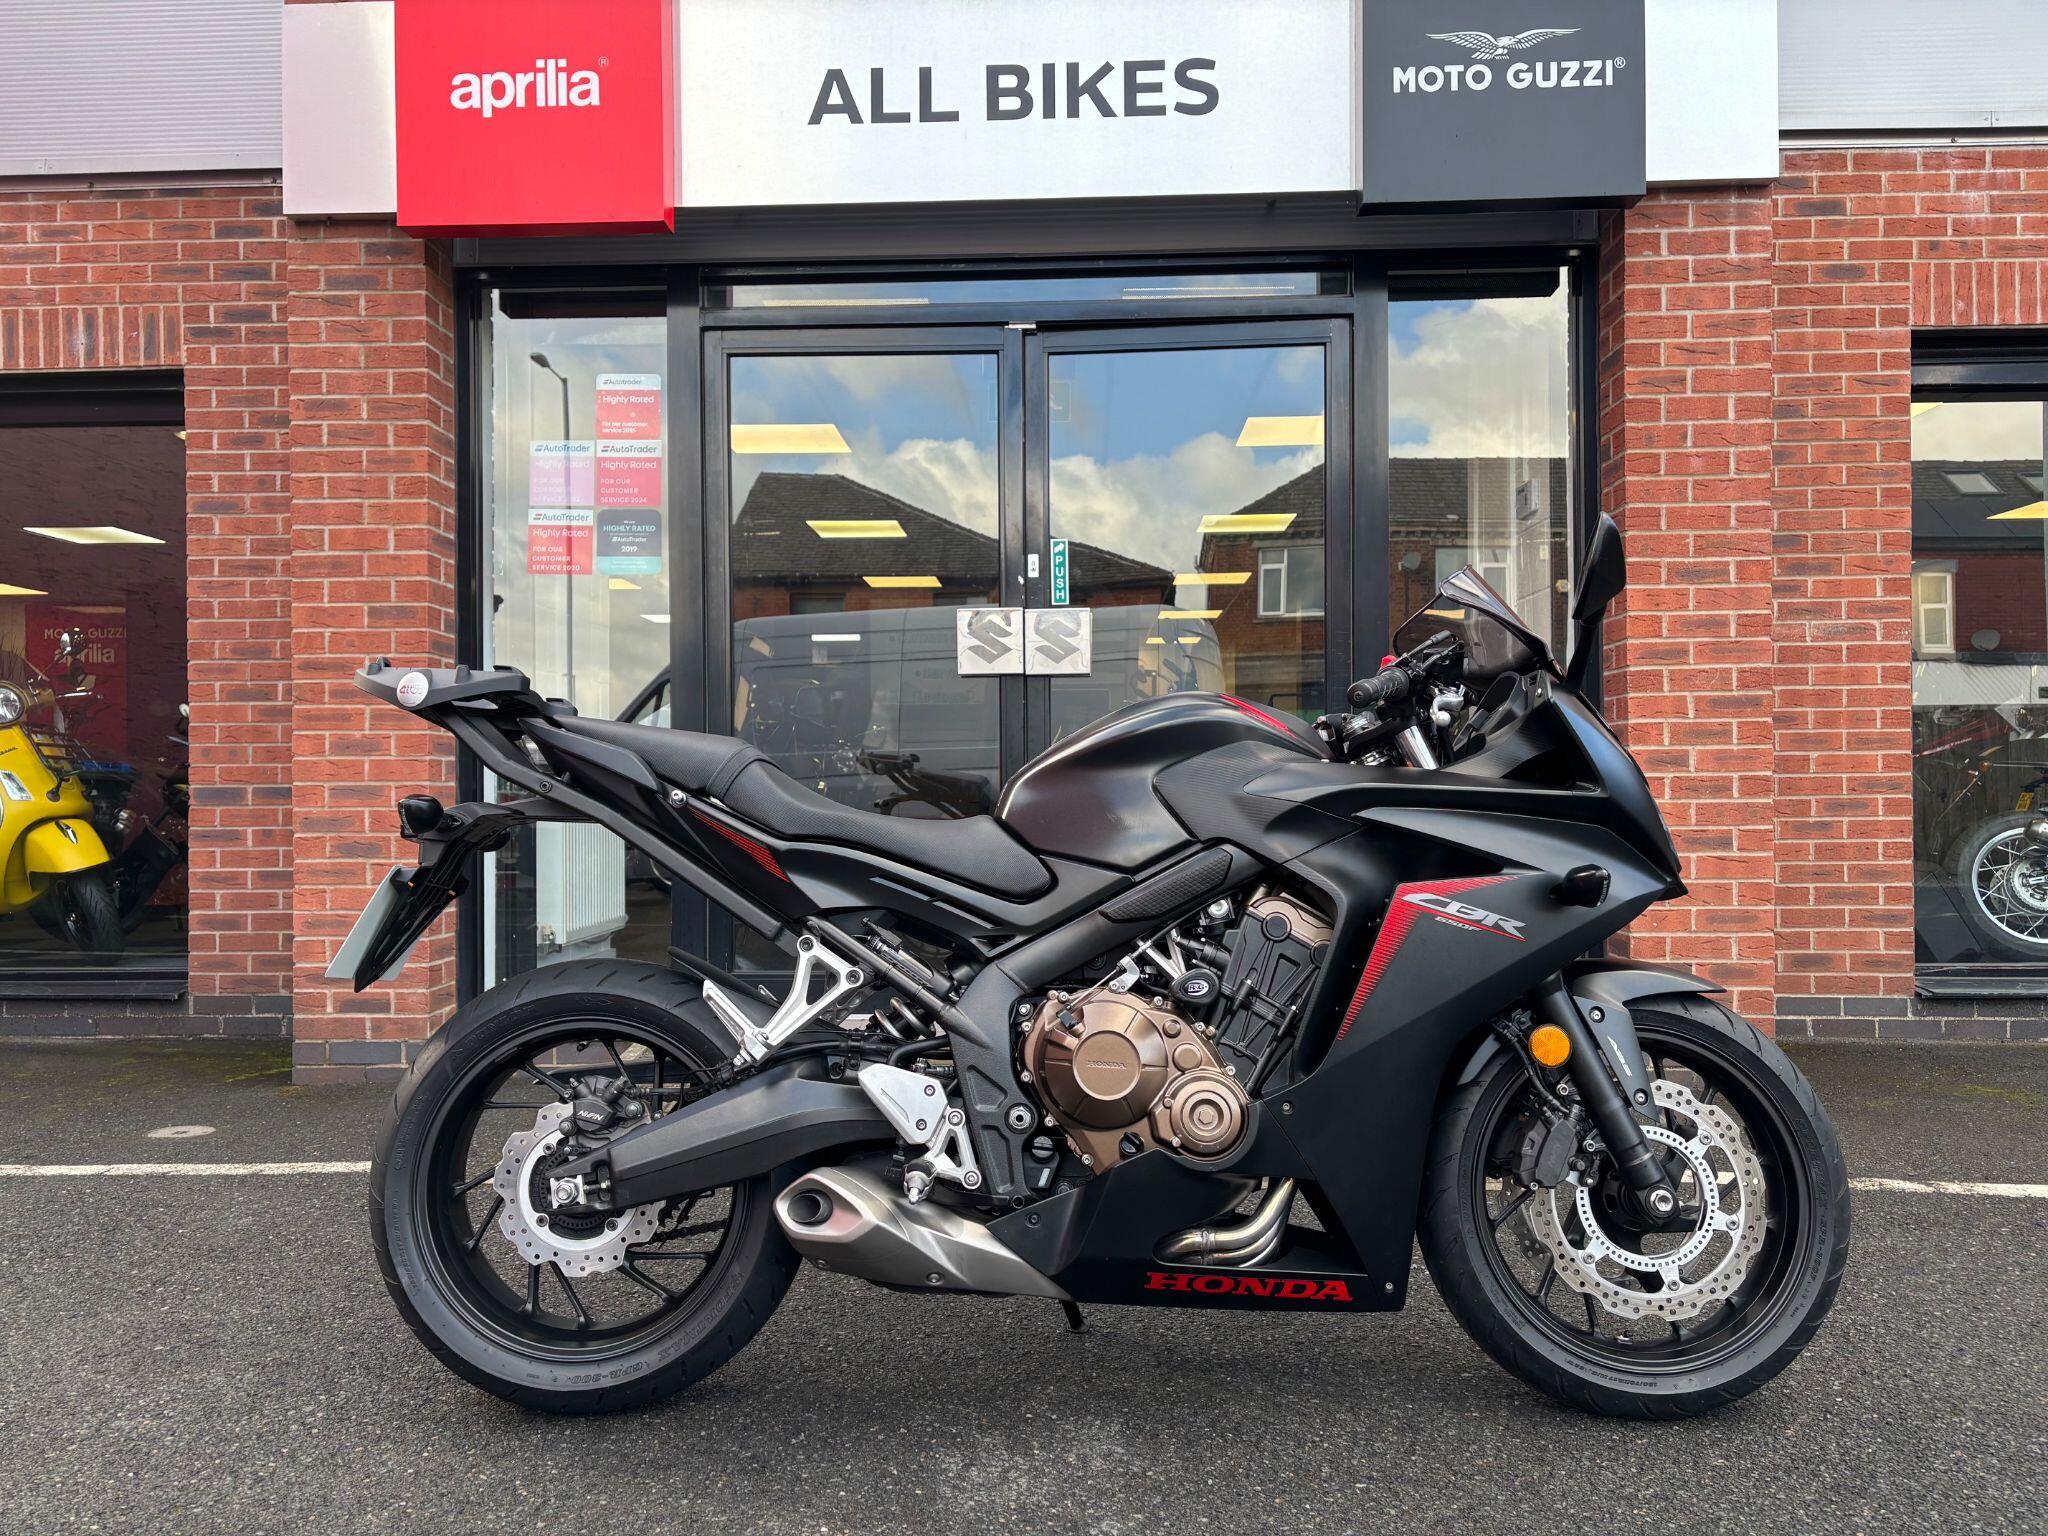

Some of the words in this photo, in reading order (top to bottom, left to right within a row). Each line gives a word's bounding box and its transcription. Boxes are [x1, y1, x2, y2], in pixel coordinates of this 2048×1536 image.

[1392, 64, 1493, 94] MOTO
[807, 66, 960, 126] ALL
[985, 57, 1220, 121] BIKES
[602, 394, 629, 405] Highly
[630, 395, 655, 403] Rated
[543, 443, 591, 452] AutoTrader
[609, 445, 658, 453] AutoTrader
[600, 460, 629, 471] Highly
[630, 460, 657, 469] Rated
[541, 513, 590, 521] AutoTrader
[532, 528, 561, 538] Highly
[562, 528, 589, 537] Rated
[603, 524, 631, 532] HIGHLY
[1055, 555, 1065, 600] PUSH
[87, 628, 127, 640] GUZZI
[1400, 892, 1527, 940] CBR
[1087, 1060, 1127, 1070] HONDA
[1143, 1271, 1354, 1302] HONDA
